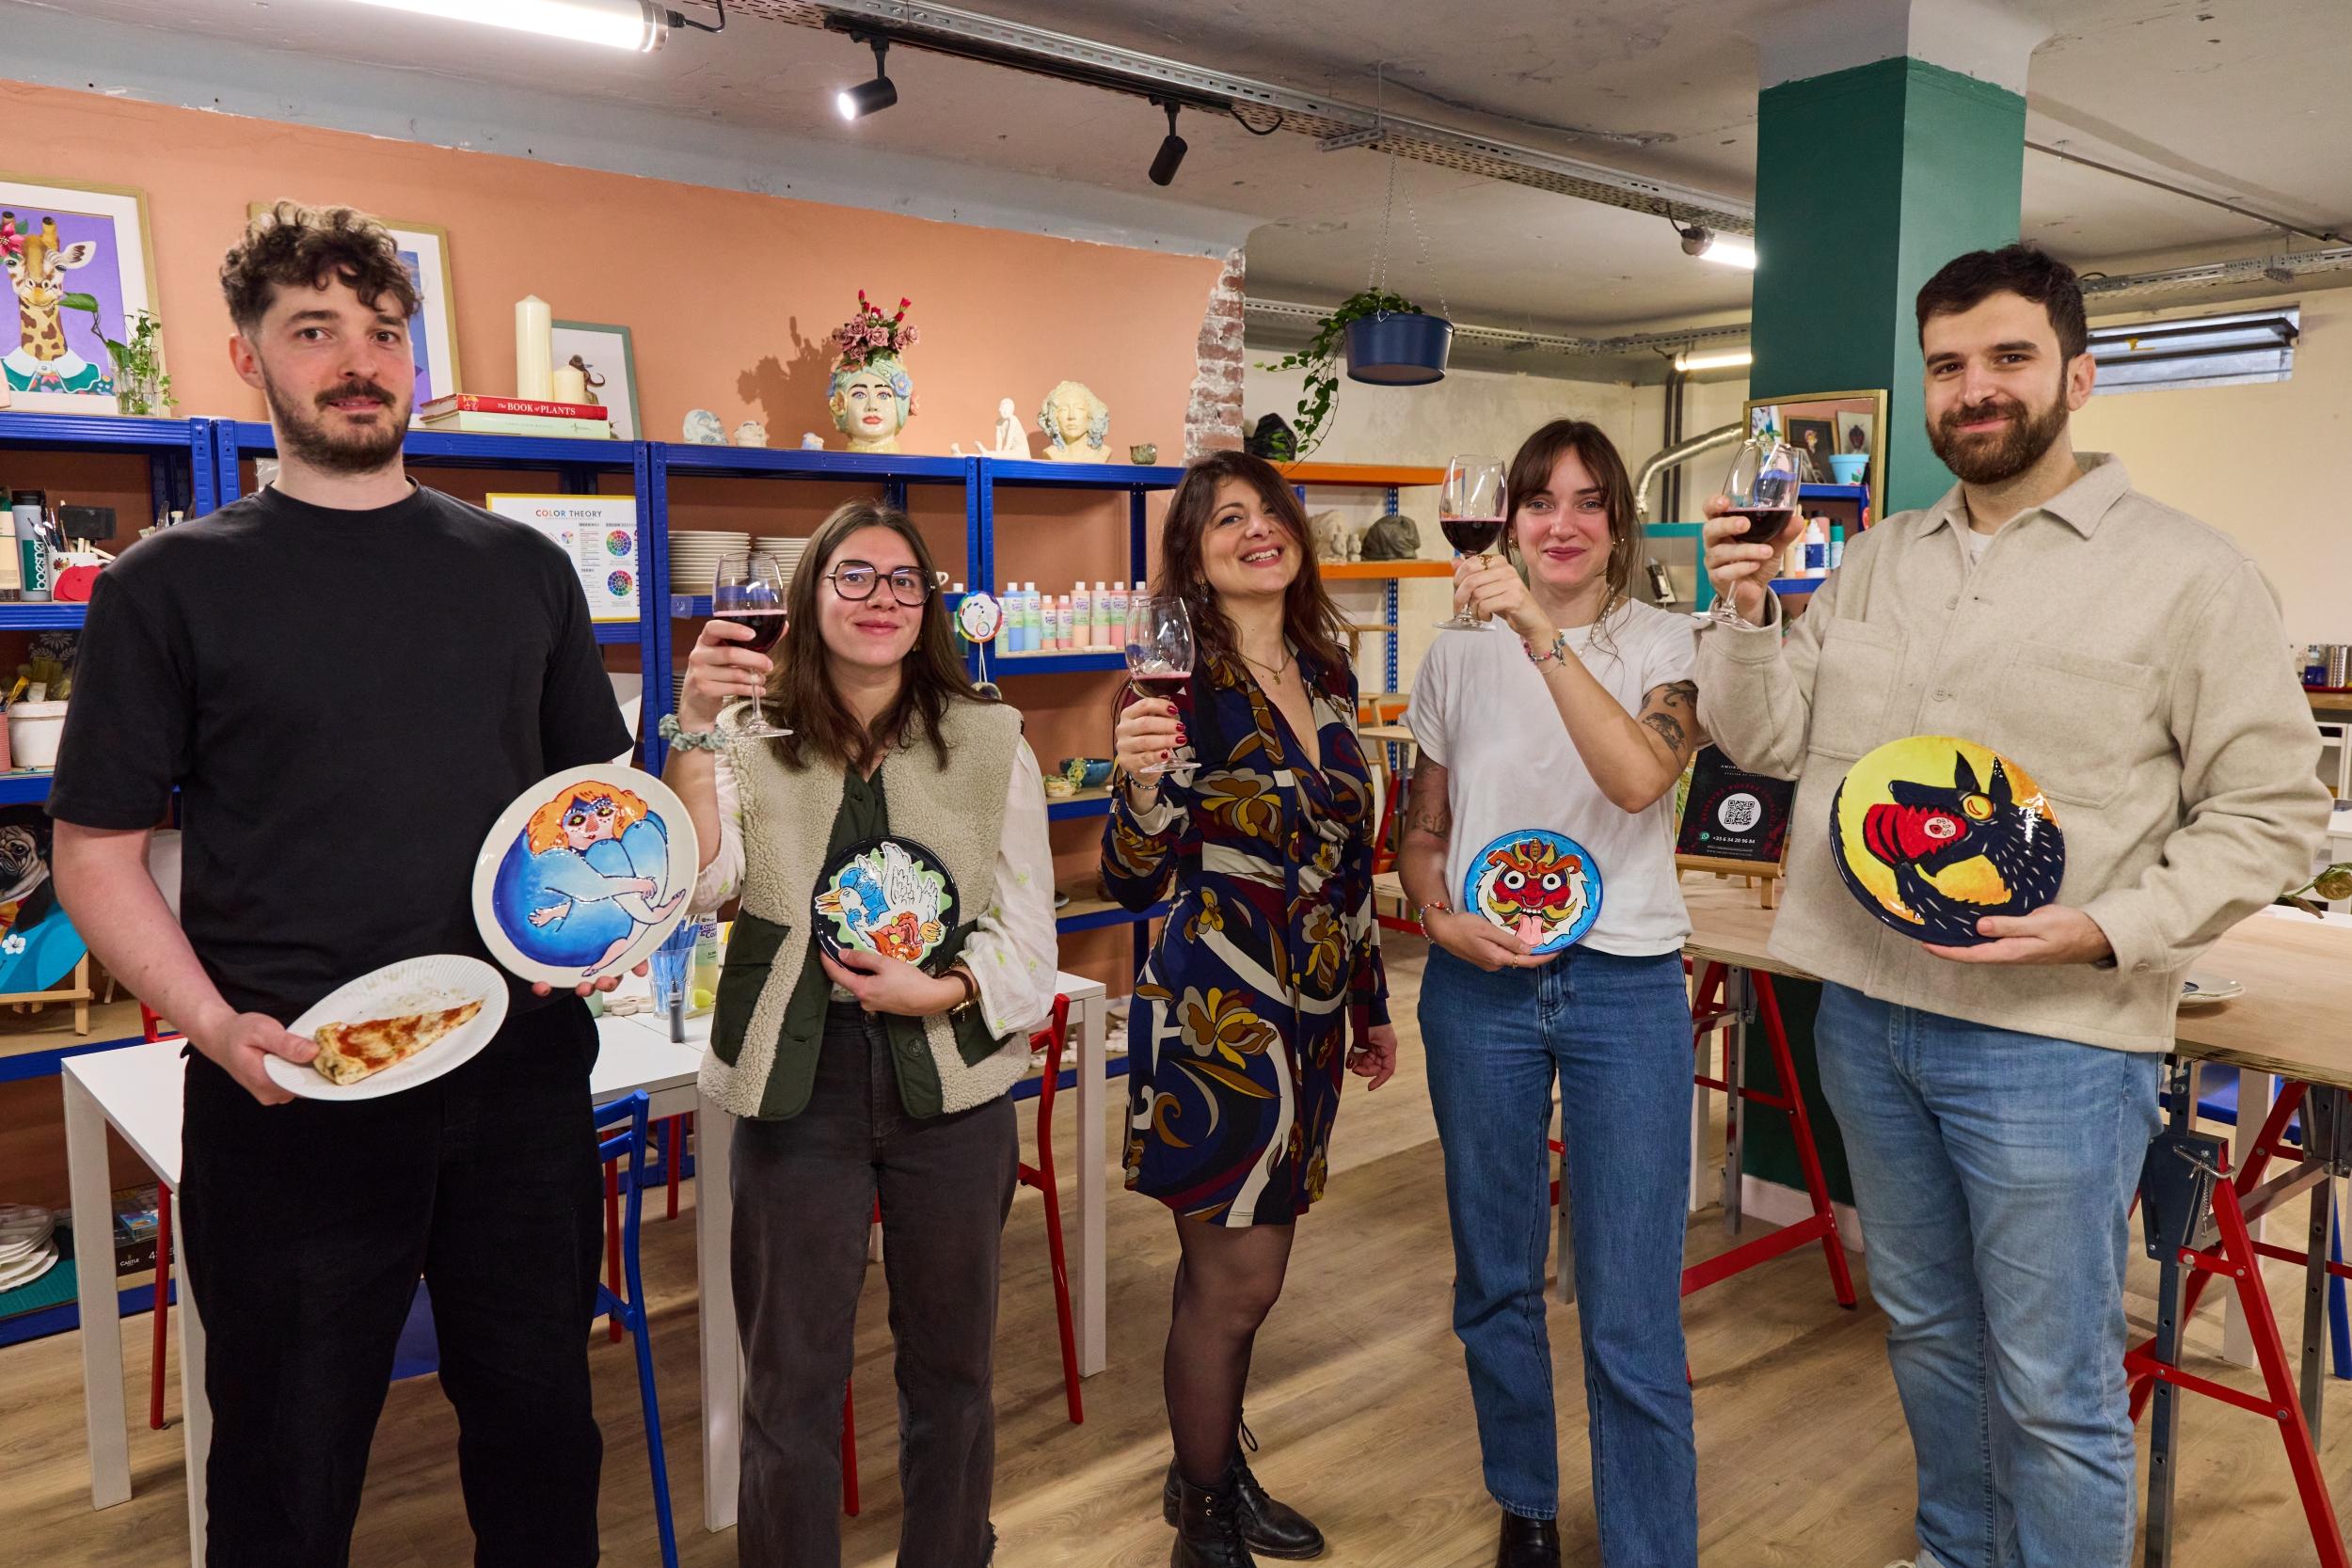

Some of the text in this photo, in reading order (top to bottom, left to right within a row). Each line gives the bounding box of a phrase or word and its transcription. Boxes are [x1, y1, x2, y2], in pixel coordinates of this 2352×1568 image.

[508, 403, 533, 412] BOOK
[541, 404, 576, 415] PLANTS
[535, 509, 602, 518] COLOR THEORY
[32, 539, 46, 591] boesner
